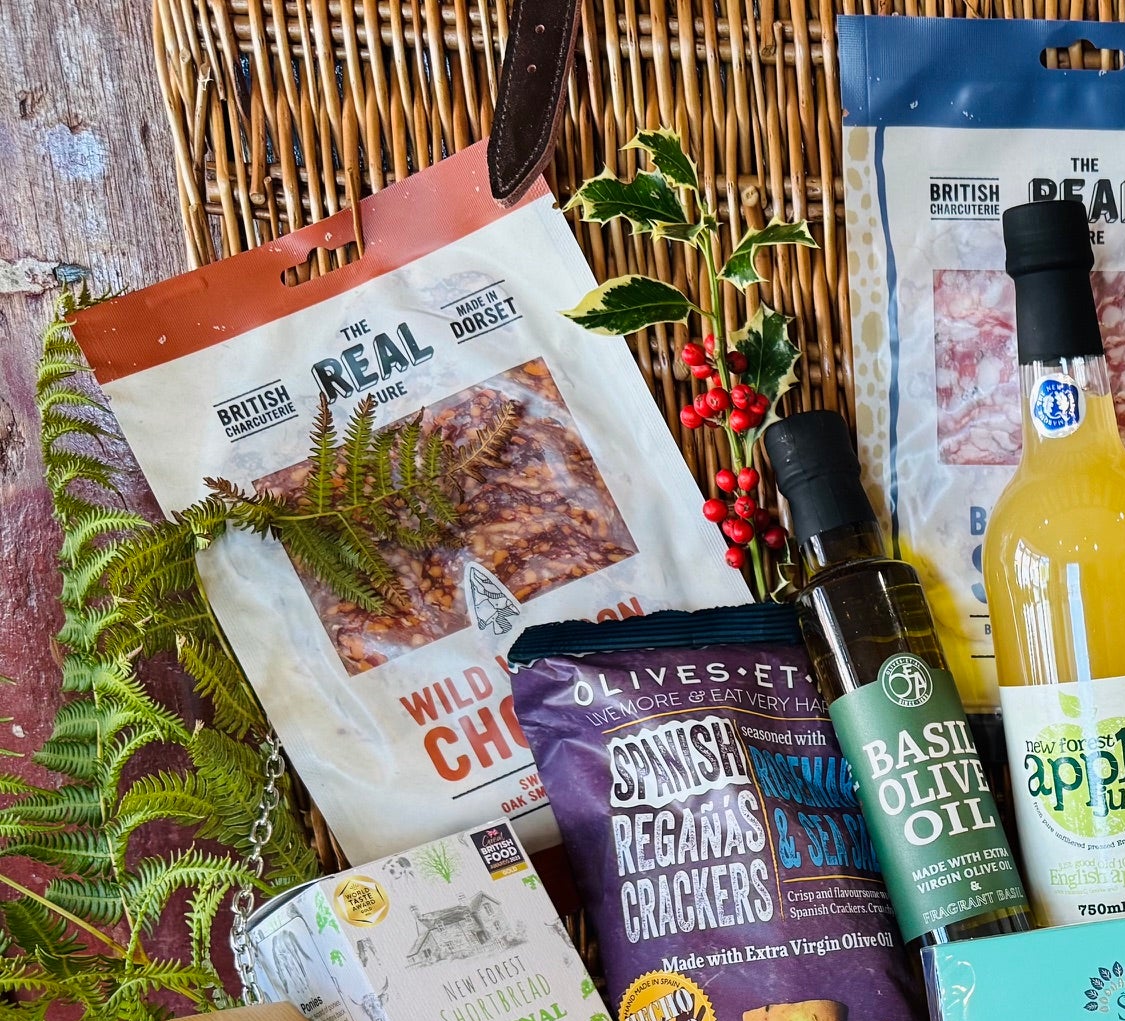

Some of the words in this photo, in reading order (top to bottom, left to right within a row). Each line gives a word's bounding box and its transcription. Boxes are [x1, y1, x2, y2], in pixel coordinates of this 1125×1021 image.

[1071, 158, 1099, 173] THE
[930, 184, 999, 202] BRITISH
[930, 203, 999, 215] CHARCUTERIE
[340, 319, 372, 343] THE
[449, 296, 519, 340] DORSET
[311, 322, 434, 404] REAL
[217, 386, 291, 427] BRITISH
[225, 401, 296, 438] CHARCUTERIE
[399, 666, 493, 727] WILD
[612, 718, 746, 802] SPANISH
[863, 720, 977, 780] BASIL
[1026, 739, 1056, 754] new
[1059, 734, 1115, 752] forest
[501, 794, 528, 814] OAK
[879, 759, 990, 816] OLIVE
[904, 797, 996, 846] OIL
[912, 861, 947, 882] MADE
[949, 852, 981, 869] WITH
[982, 847, 1009, 863] EXTRA
[621, 858, 774, 945] CRACKERS
[662, 954, 704, 974] Made
[707, 948, 743, 967] with
[746, 941, 788, 962] Extra
[790, 936, 840, 960] Virgin
[842, 933, 877, 951] Olive
[878, 932, 894, 948] Oil
[443, 975, 477, 1003] NEW
[477, 955, 526, 990] FOREST
